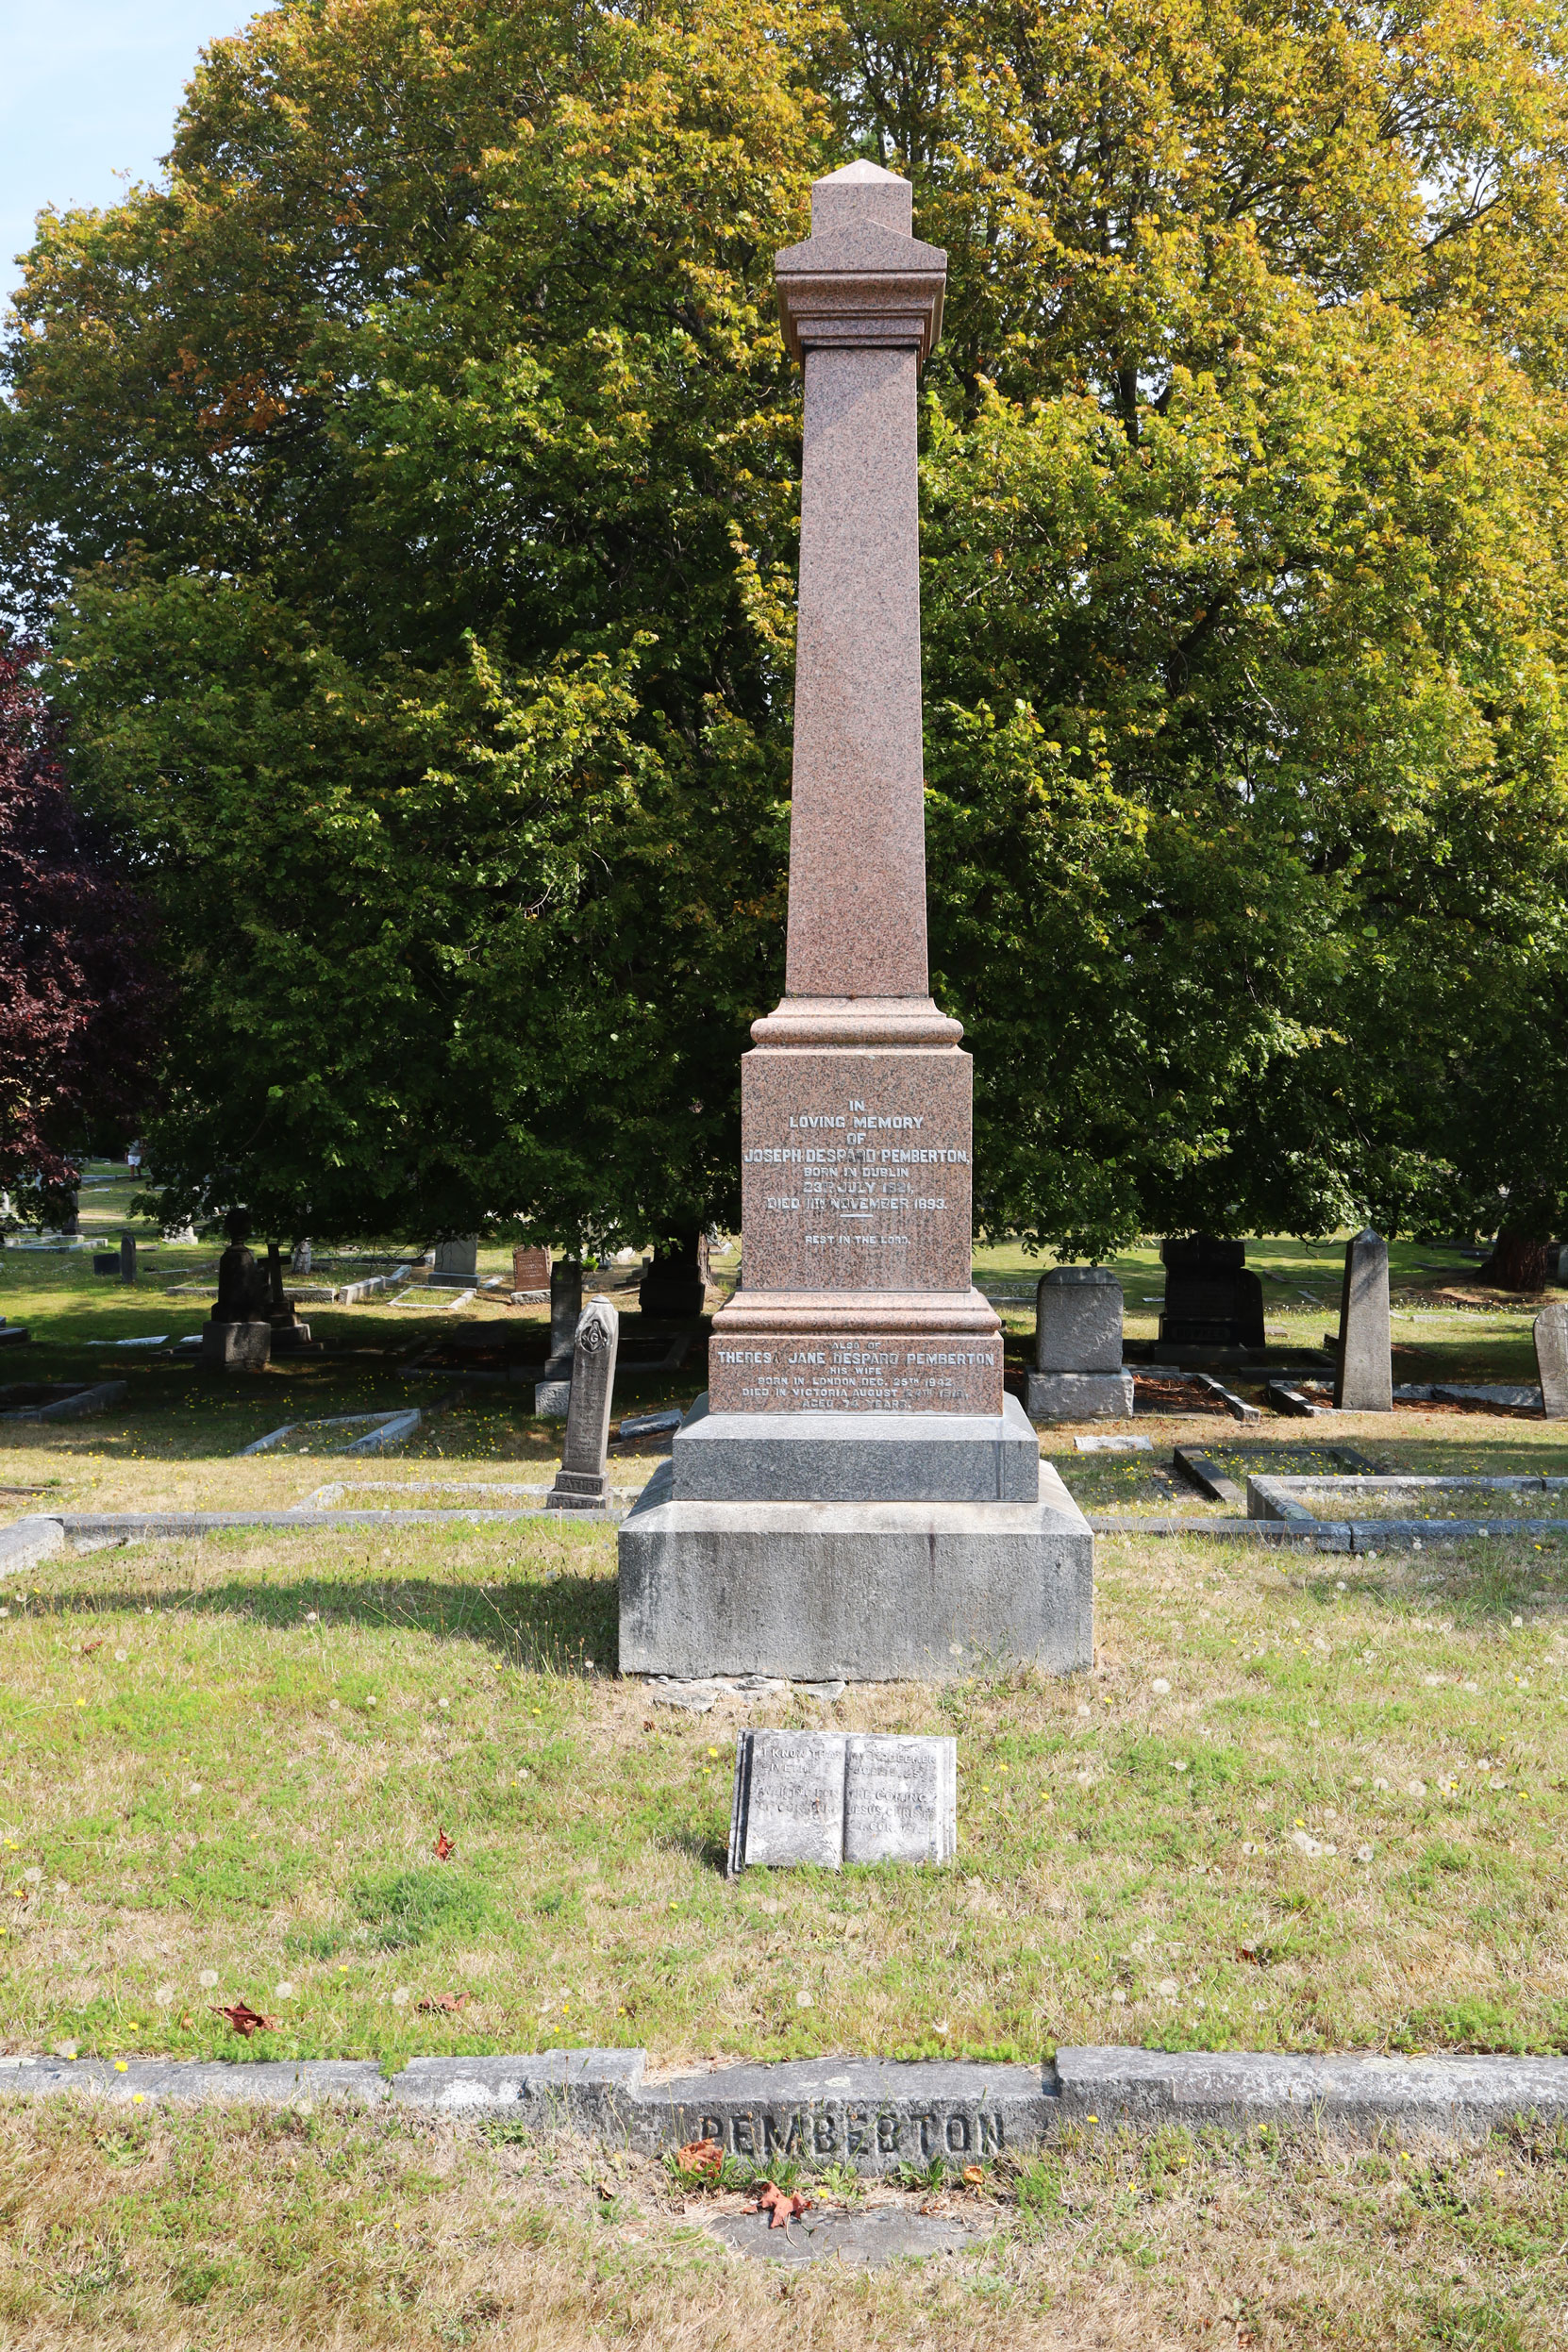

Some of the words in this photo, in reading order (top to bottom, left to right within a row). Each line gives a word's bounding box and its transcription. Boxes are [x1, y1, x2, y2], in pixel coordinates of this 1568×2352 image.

[849, 1100, 865, 1111] IN
[790, 1117, 845, 1128] LOVING
[853, 1117, 924, 1129] MEMORY
[846, 1133, 866, 1145] OF
[744, 1149, 802, 1163] JOSEPH
[806, 1149, 876, 1163] DESPARD
[881, 1150, 970, 1165] PEMBERTON,
[804, 1167, 838, 1177] BORN
[843, 1167, 858, 1177] IN
[862, 1167, 909, 1177] DUBLIN
[837, 1182, 876, 1193] JULY
[767, 1198, 800, 1209] DIED
[830, 1198, 909, 1209] NOVEMBER
[914, 1198, 948, 1209] 1893.
[805, 1236, 834, 1244] REST
[839, 1236, 851, 1244] IN
[855, 1236, 876, 1244] THE
[881, 1236, 911, 1244] LORD.
[832, 1342, 859, 1350] ALSO
[867, 1342, 881, 1350] OF
[717, 1351, 780, 1364] THERESA
[788, 1352, 826, 1364] JANE
[833, 1352, 899, 1365] DESPARD
[907, 1353, 994, 1366] PEMBERTON
[855, 1367, 882, 1376] WIFE
[758, 1376, 788, 1385] BORN
[794, 1376, 805, 1385] IN
[812, 1377, 856, 1386] LONDON
[861, 1377, 888, 1386] DEC.
[742, 1388, 769, 1396] DIED
[776, 1388, 786, 1396] IN
[792, 1388, 848, 1396] VICTORIA
[853, 1389, 898, 1397] AUGUST
[559, 1477, 600, 1491] FATHER
[700, 2111, 1007, 2157] PEMBERTON
